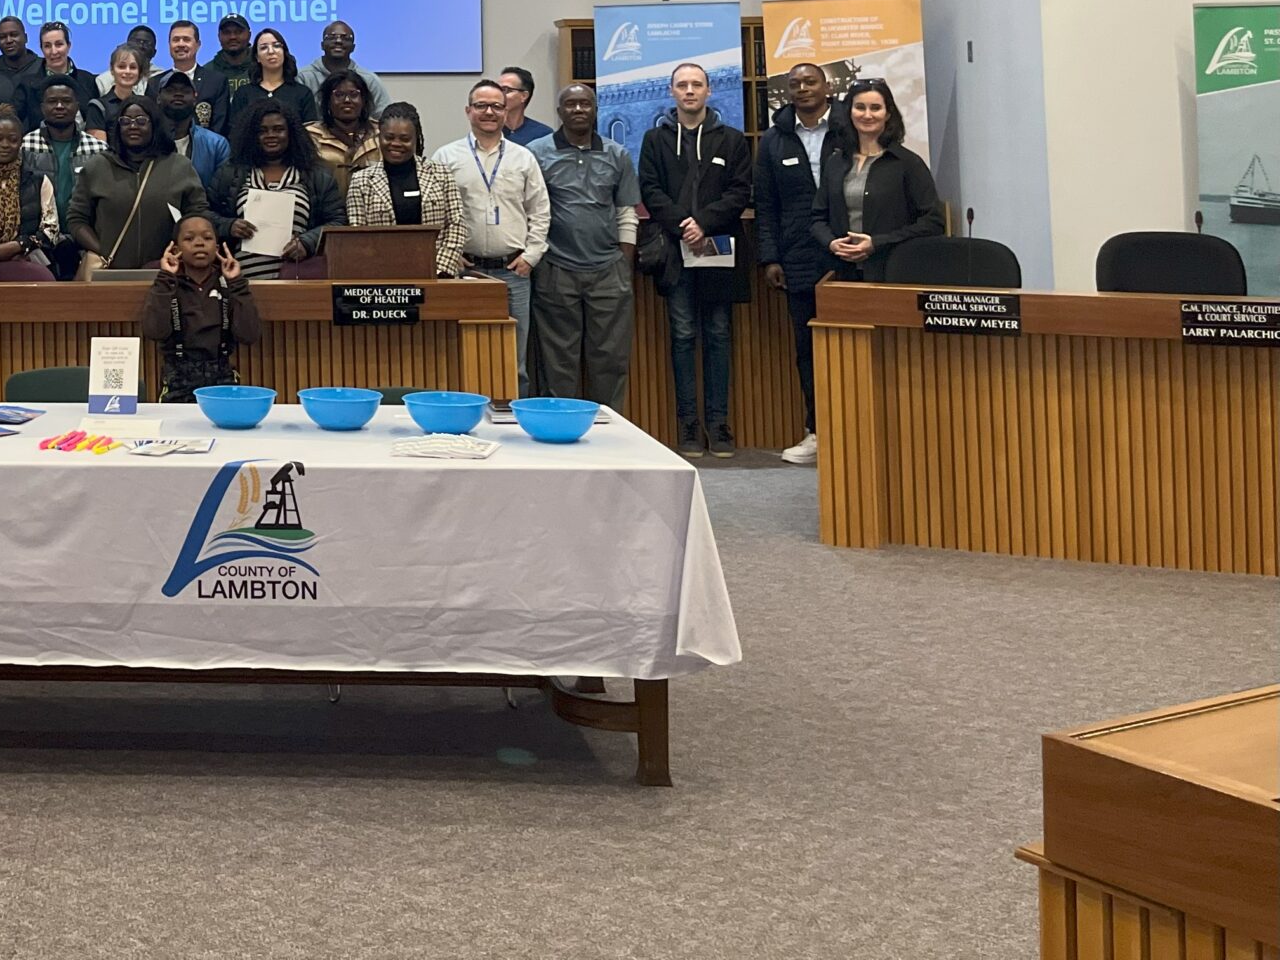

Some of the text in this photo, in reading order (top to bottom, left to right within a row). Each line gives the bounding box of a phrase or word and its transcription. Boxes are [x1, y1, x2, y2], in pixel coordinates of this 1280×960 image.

[344, 288, 421, 296] MEDICAL OFFICER
[929, 294, 1000, 304] GENERAL MANAGER
[925, 302, 1007, 313] CULTURAL SERVICES
[1181, 303, 1280, 315] G.M. FINANCE, FACILITIE
[352, 310, 407, 319] DR. DUECK
[1197, 313, 1267, 323] & COURT SERVICES
[925, 316, 1019, 330] ANDREW MEYER
[1182, 327, 1217, 337] LARRY
[217, 565, 296, 577] COUNTY OF
[197, 579, 317, 600] LAMBTON
